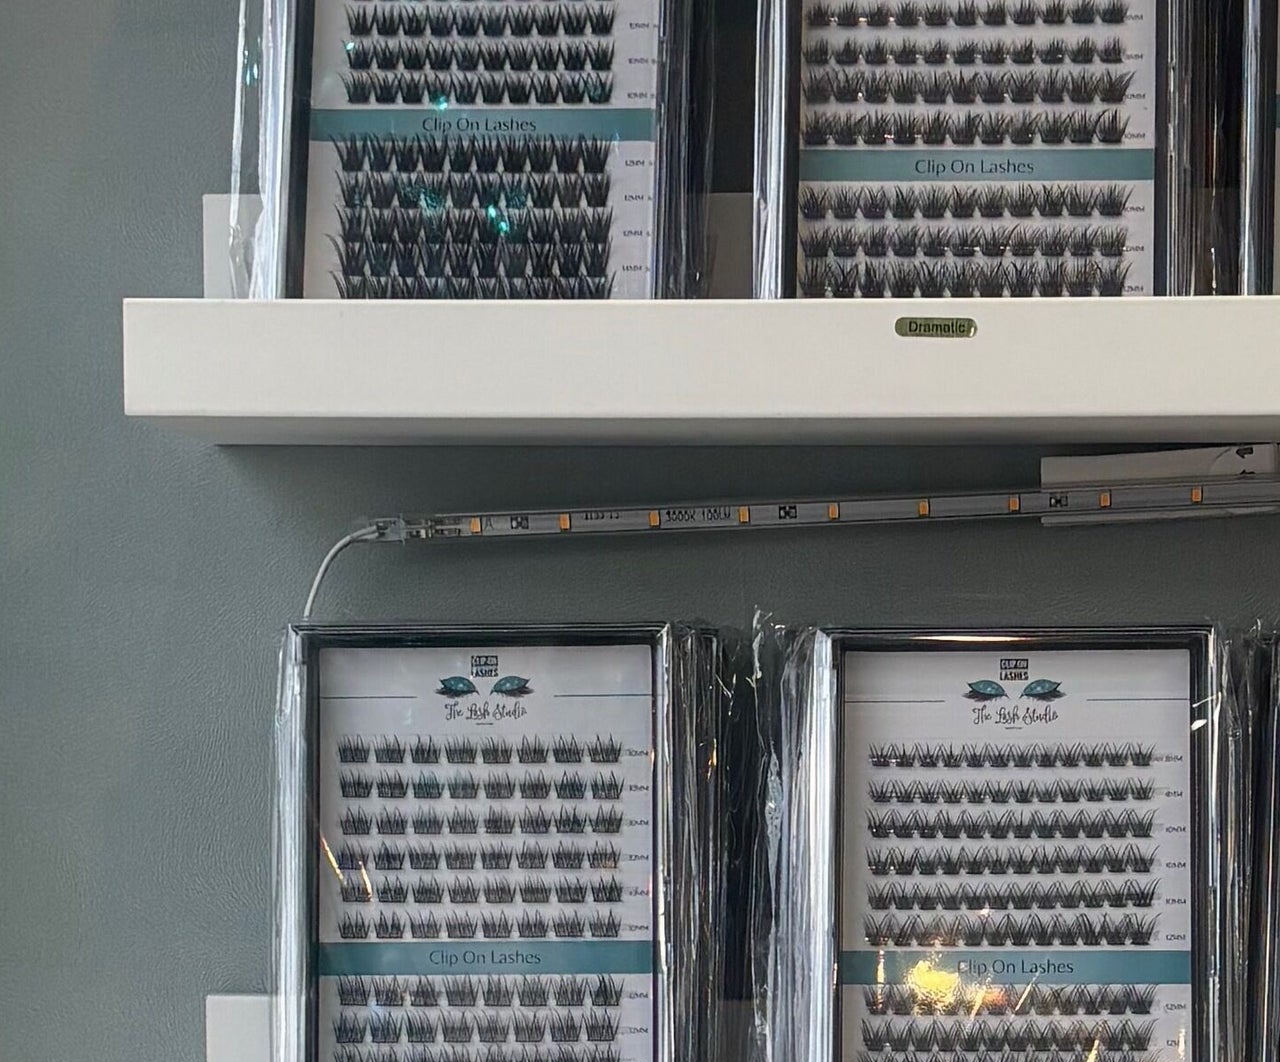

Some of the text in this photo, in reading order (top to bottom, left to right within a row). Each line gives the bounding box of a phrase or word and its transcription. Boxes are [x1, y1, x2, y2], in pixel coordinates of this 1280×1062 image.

[422, 117, 536, 134] Clip On Lashes
[915, 159, 1034, 176] Clip On Lashes
[908, 320, 965, 334] Dramatic
[471, 668, 498, 678] LASHES
[1000, 671, 1029, 681] LASHES
[429, 950, 541, 966] Clip On Lashes
[992, 959, 1015, 974] On
[1021, 959, 1074, 974] Lashes
